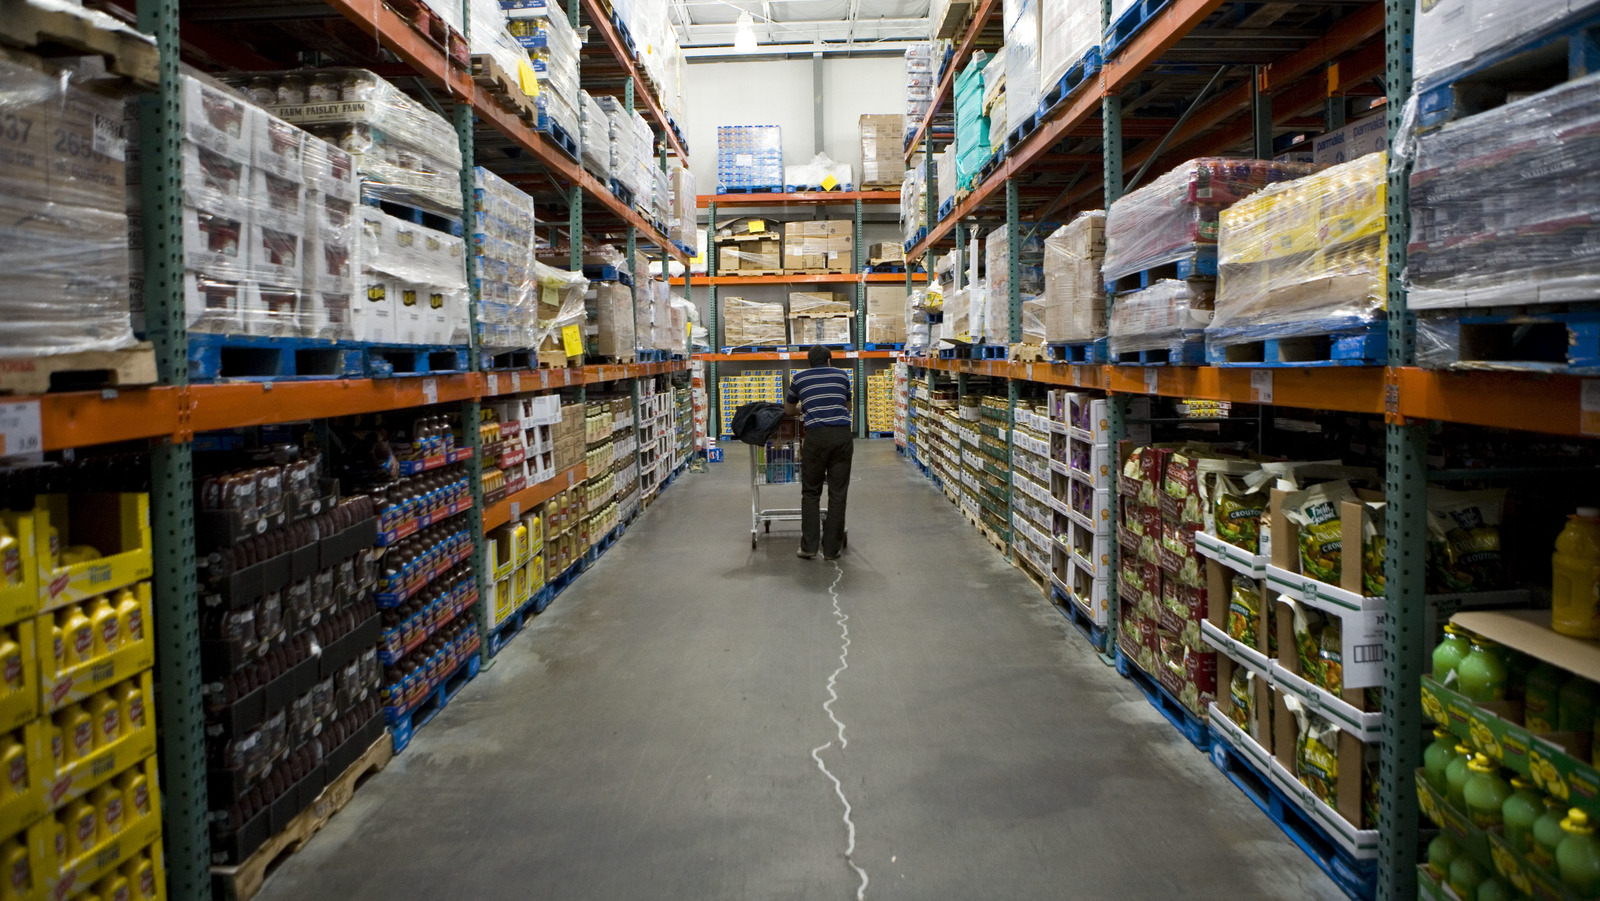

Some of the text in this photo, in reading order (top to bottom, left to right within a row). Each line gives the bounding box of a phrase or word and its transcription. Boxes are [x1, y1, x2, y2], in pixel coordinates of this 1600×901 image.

[280, 103, 365, 117] FARM PAISLEY FARM
[1353, 114, 1386, 140] parmalat
[1317, 131, 1345, 153] parmalat
